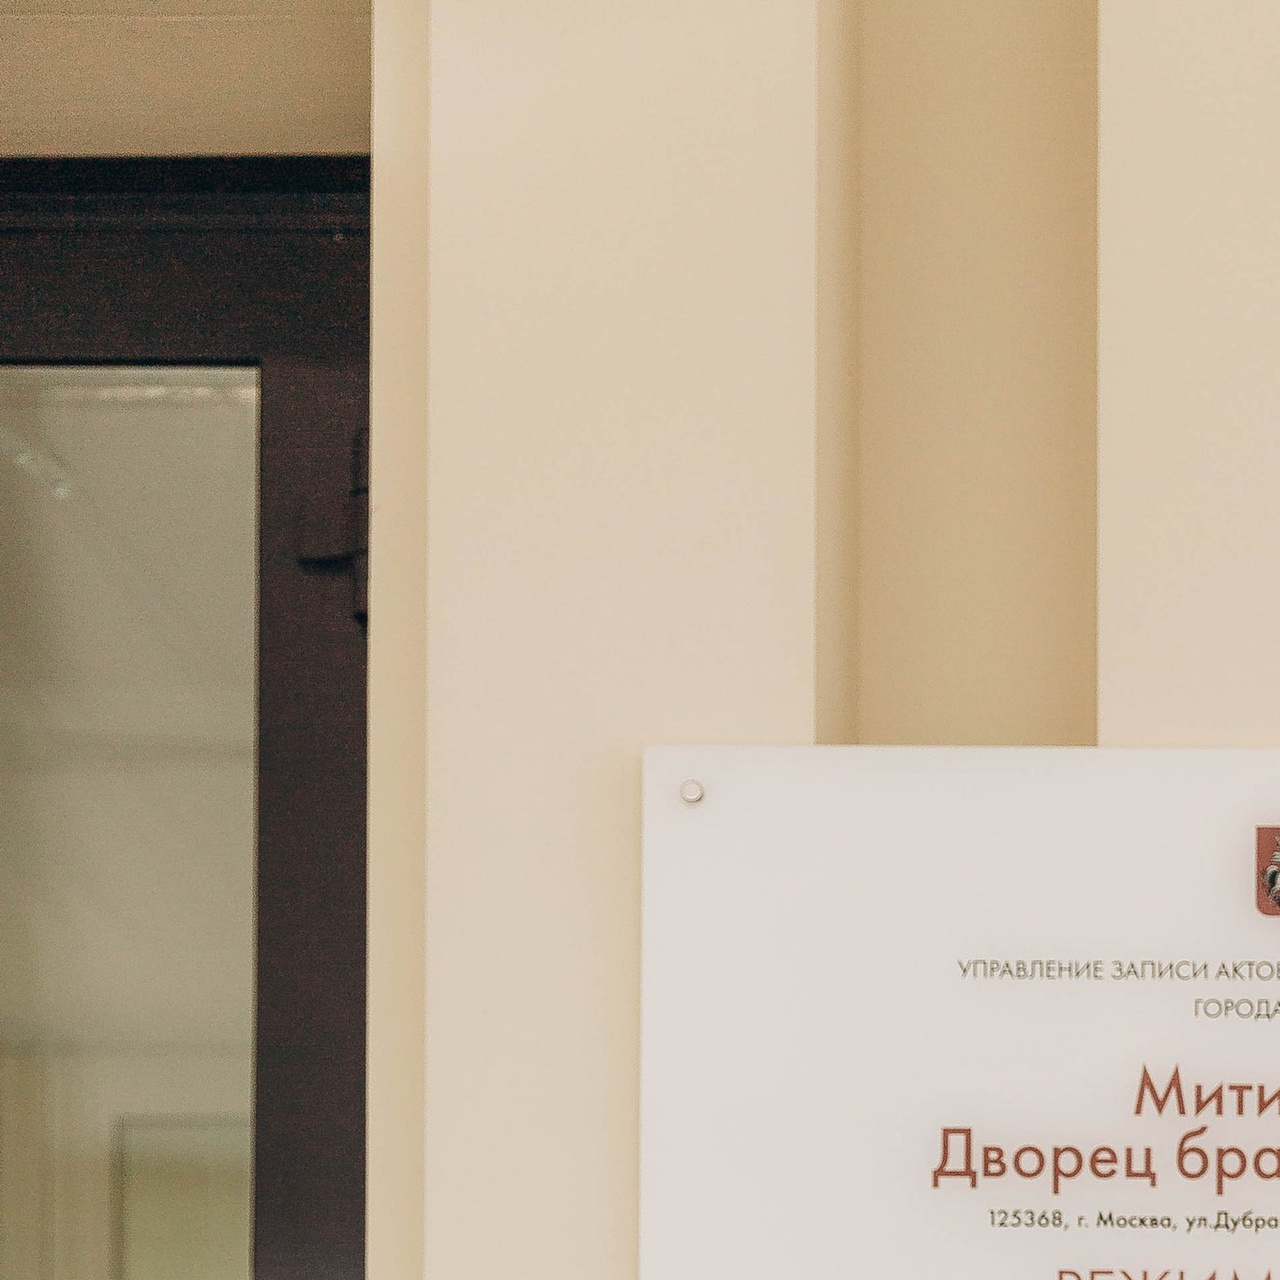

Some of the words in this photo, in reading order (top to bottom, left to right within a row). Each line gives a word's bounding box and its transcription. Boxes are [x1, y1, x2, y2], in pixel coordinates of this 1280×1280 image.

[957, 959, 1103, 981] УПРАВЛЕНИЕ
[1111, 959, 1209, 981] ЗАПИСИ
[931, 1127, 1157, 1195] Дворец
[989, 1209, 1069, 1230] 125368,
[1076, 1214, 1093, 1229] г.
[1096, 1211, 1177, 1231] Москва,
